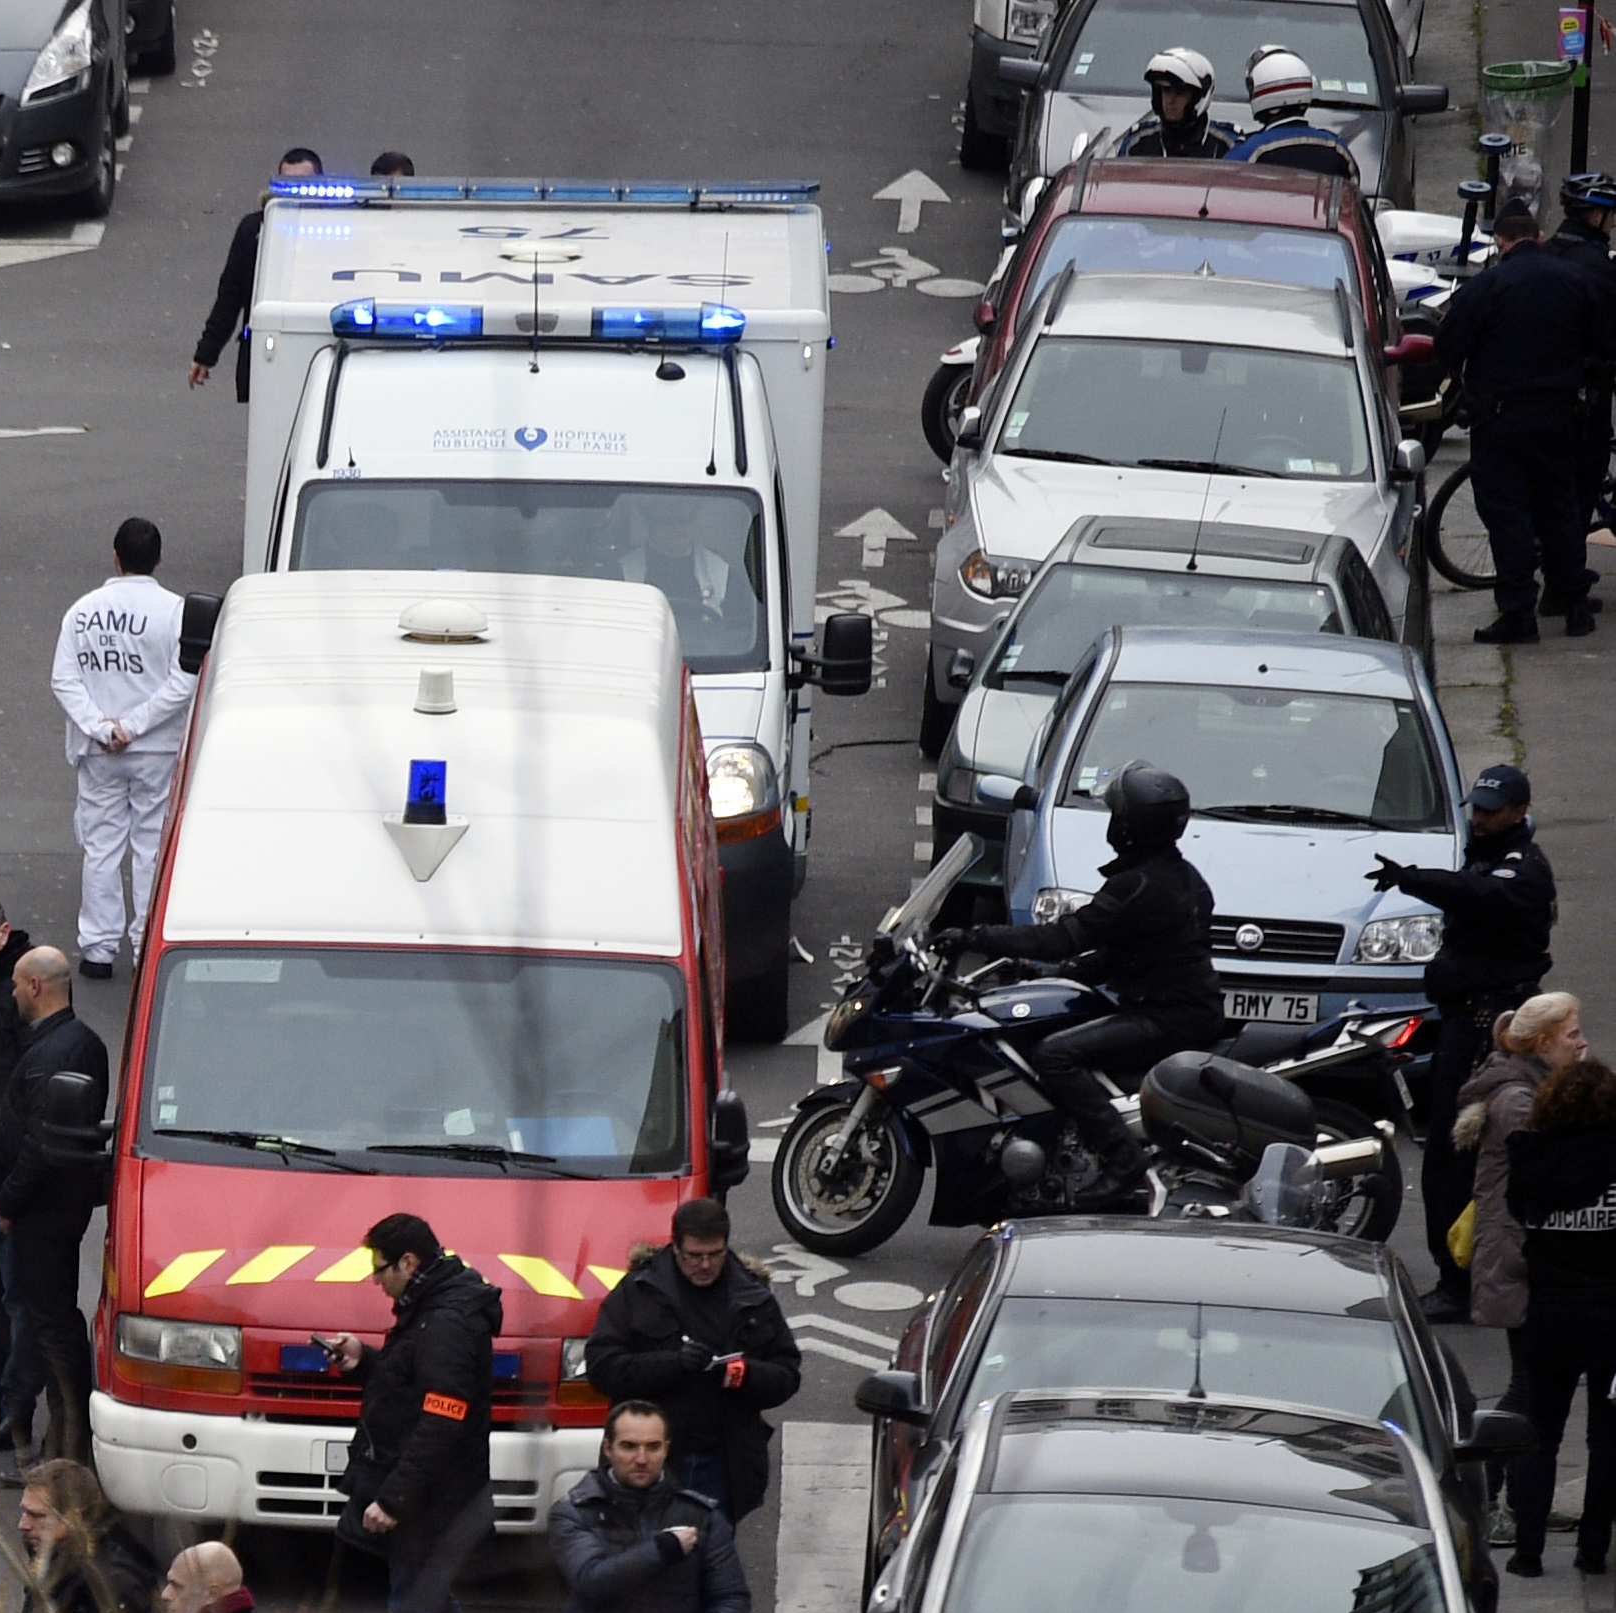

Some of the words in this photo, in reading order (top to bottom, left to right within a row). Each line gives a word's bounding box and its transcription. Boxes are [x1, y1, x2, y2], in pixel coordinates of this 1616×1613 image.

[331, 270, 753, 286] SAMU
[433, 429, 507, 438] ASSISTANCE
[433, 438, 507, 450] PUBLIQUE
[554, 439, 572, 449] DE
[583, 440, 628, 452] PARIS
[75, 610, 148, 637] SAMU
[99, 634, 118, 647] DE
[77, 650, 145, 674] PARIS
[1232, 994, 1274, 1018] RMY
[1283, 998, 1310, 1020] 75
[1546, 1209, 1616, 1230] DICIAIRE
[426, 1395, 466, 1417] POLICE
